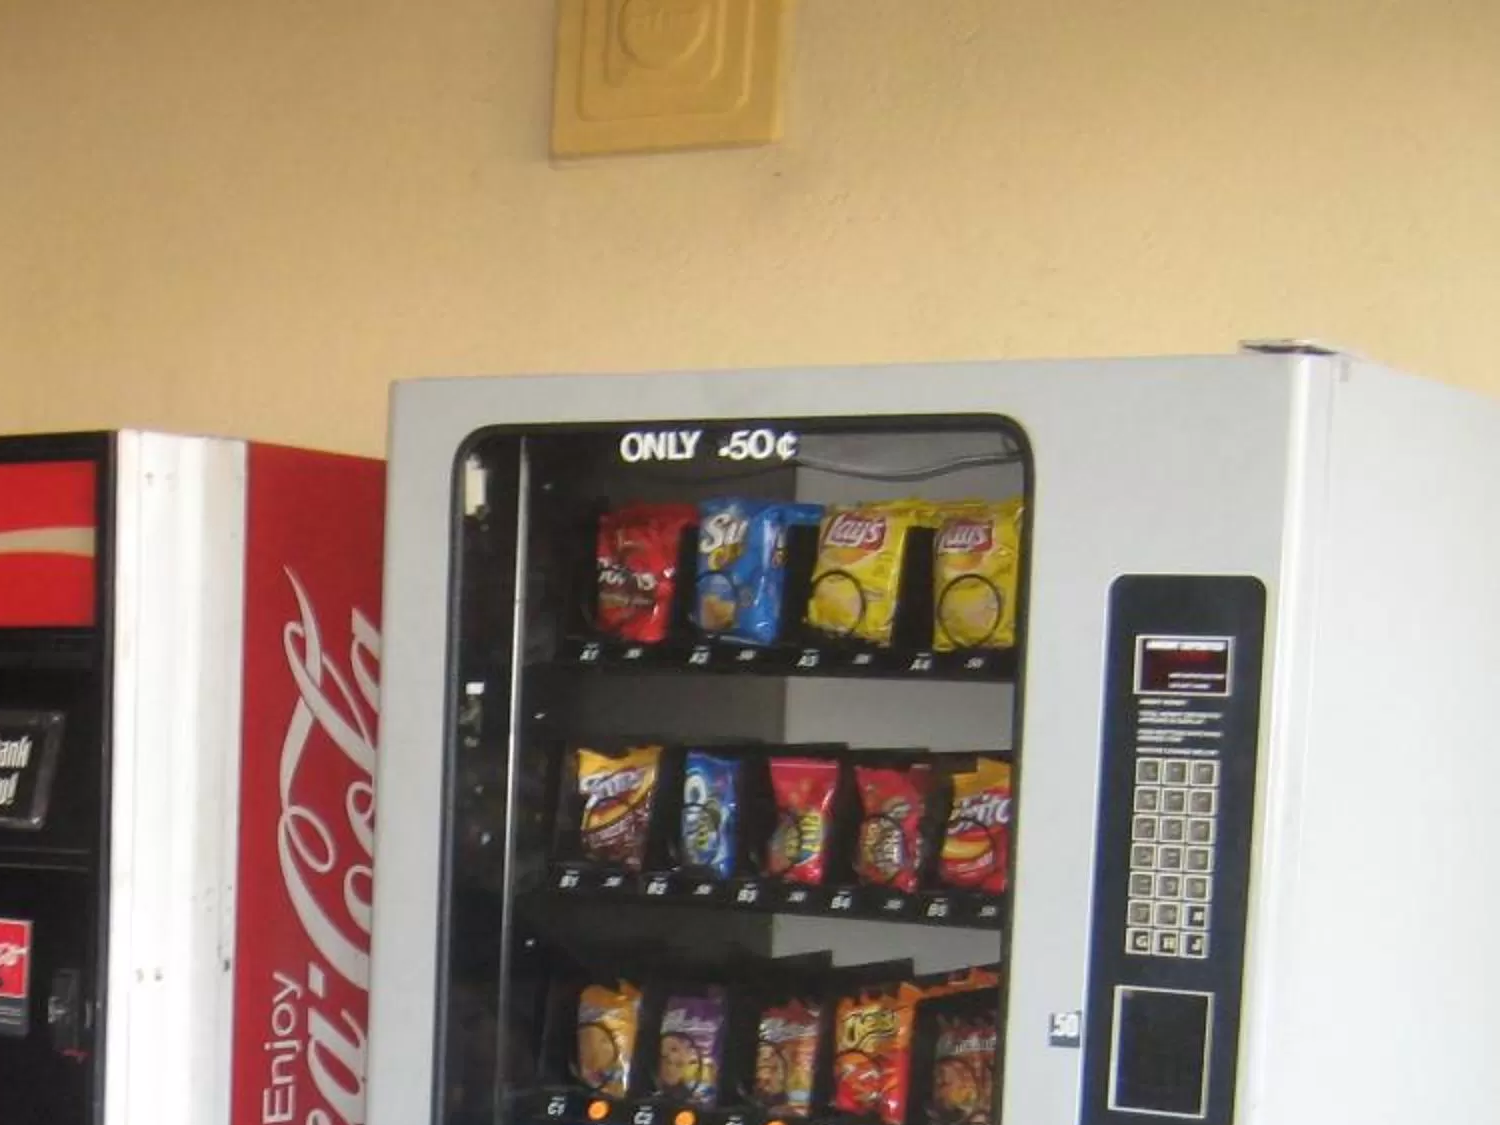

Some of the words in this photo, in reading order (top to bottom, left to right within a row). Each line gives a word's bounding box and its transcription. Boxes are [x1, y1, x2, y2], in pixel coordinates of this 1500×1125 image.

[619, 429, 703, 463] ONLY
[718, 428, 798, 462] .50¢
[262, 972, 303, 1124] Enjoy
